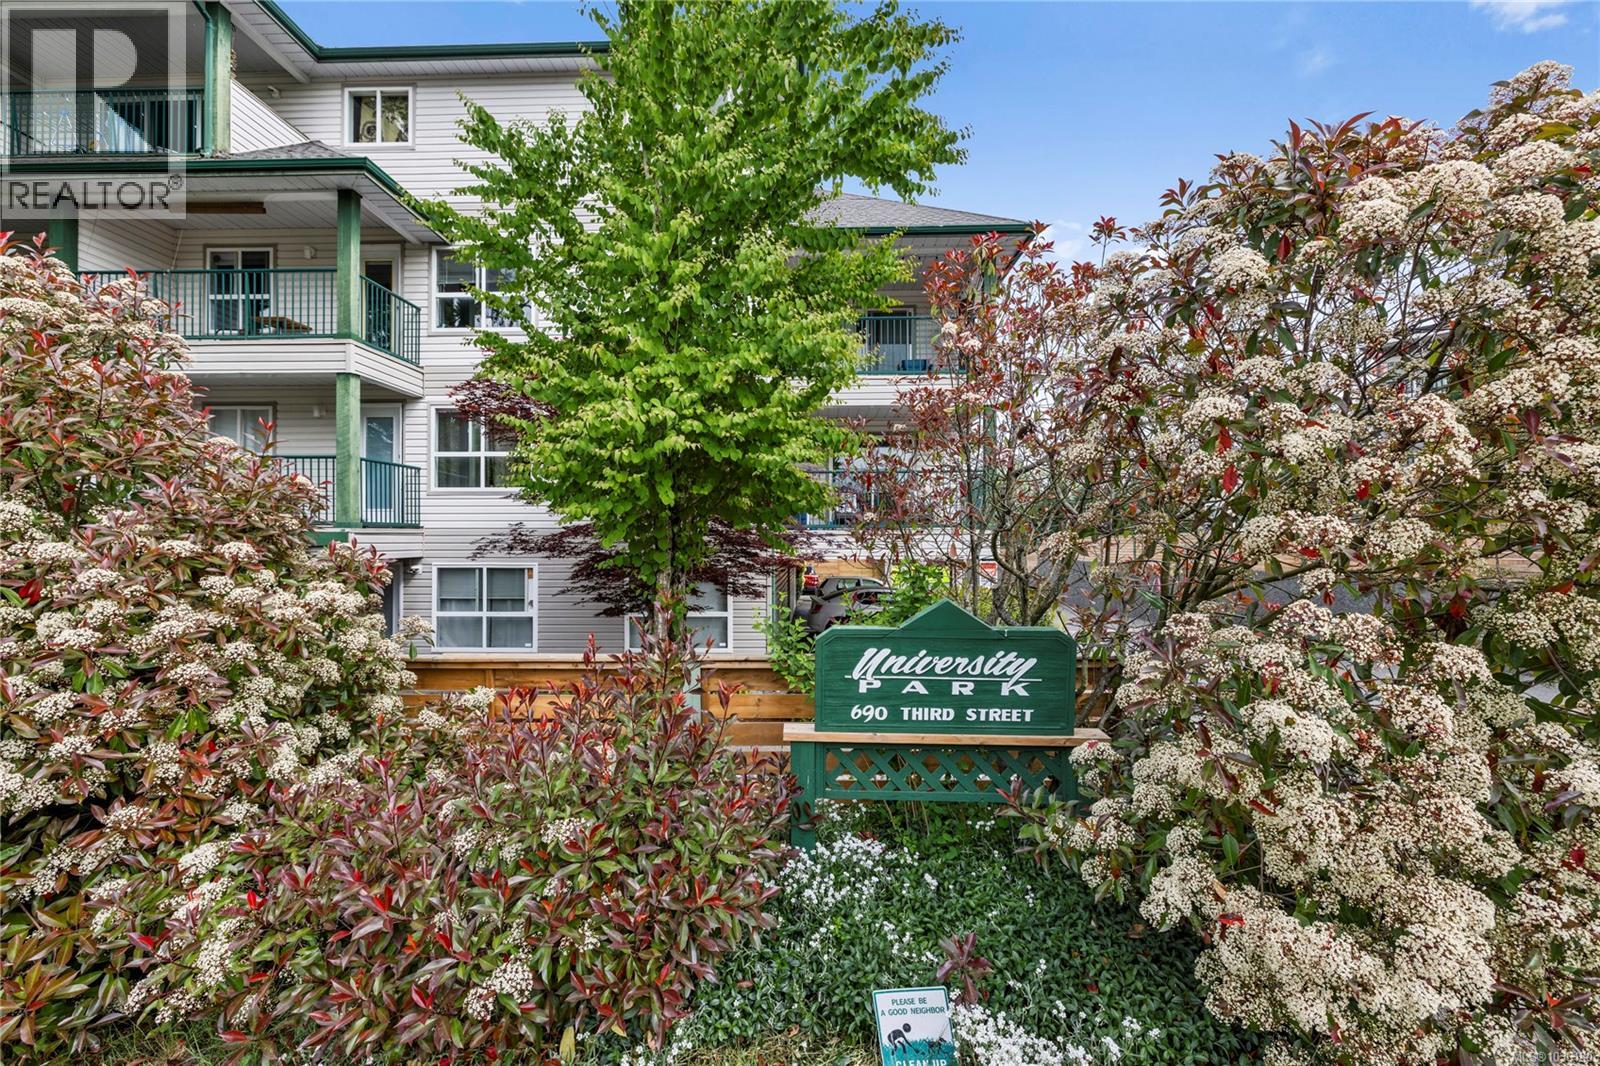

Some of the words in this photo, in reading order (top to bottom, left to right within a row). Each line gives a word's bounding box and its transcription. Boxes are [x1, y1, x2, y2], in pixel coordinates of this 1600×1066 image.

[852, 647, 1038, 681] University
[858, 679, 1030, 696] PARK
[851, 704, 888, 723] 690
[900, 707, 955, 722] THIRD
[966, 708, 1034, 722] STREET
[891, 998, 915, 1006] PLEASE
[888, 1008, 907, 1016] GOOD
[910, 1006, 945, 1014] NEIGHBOR
